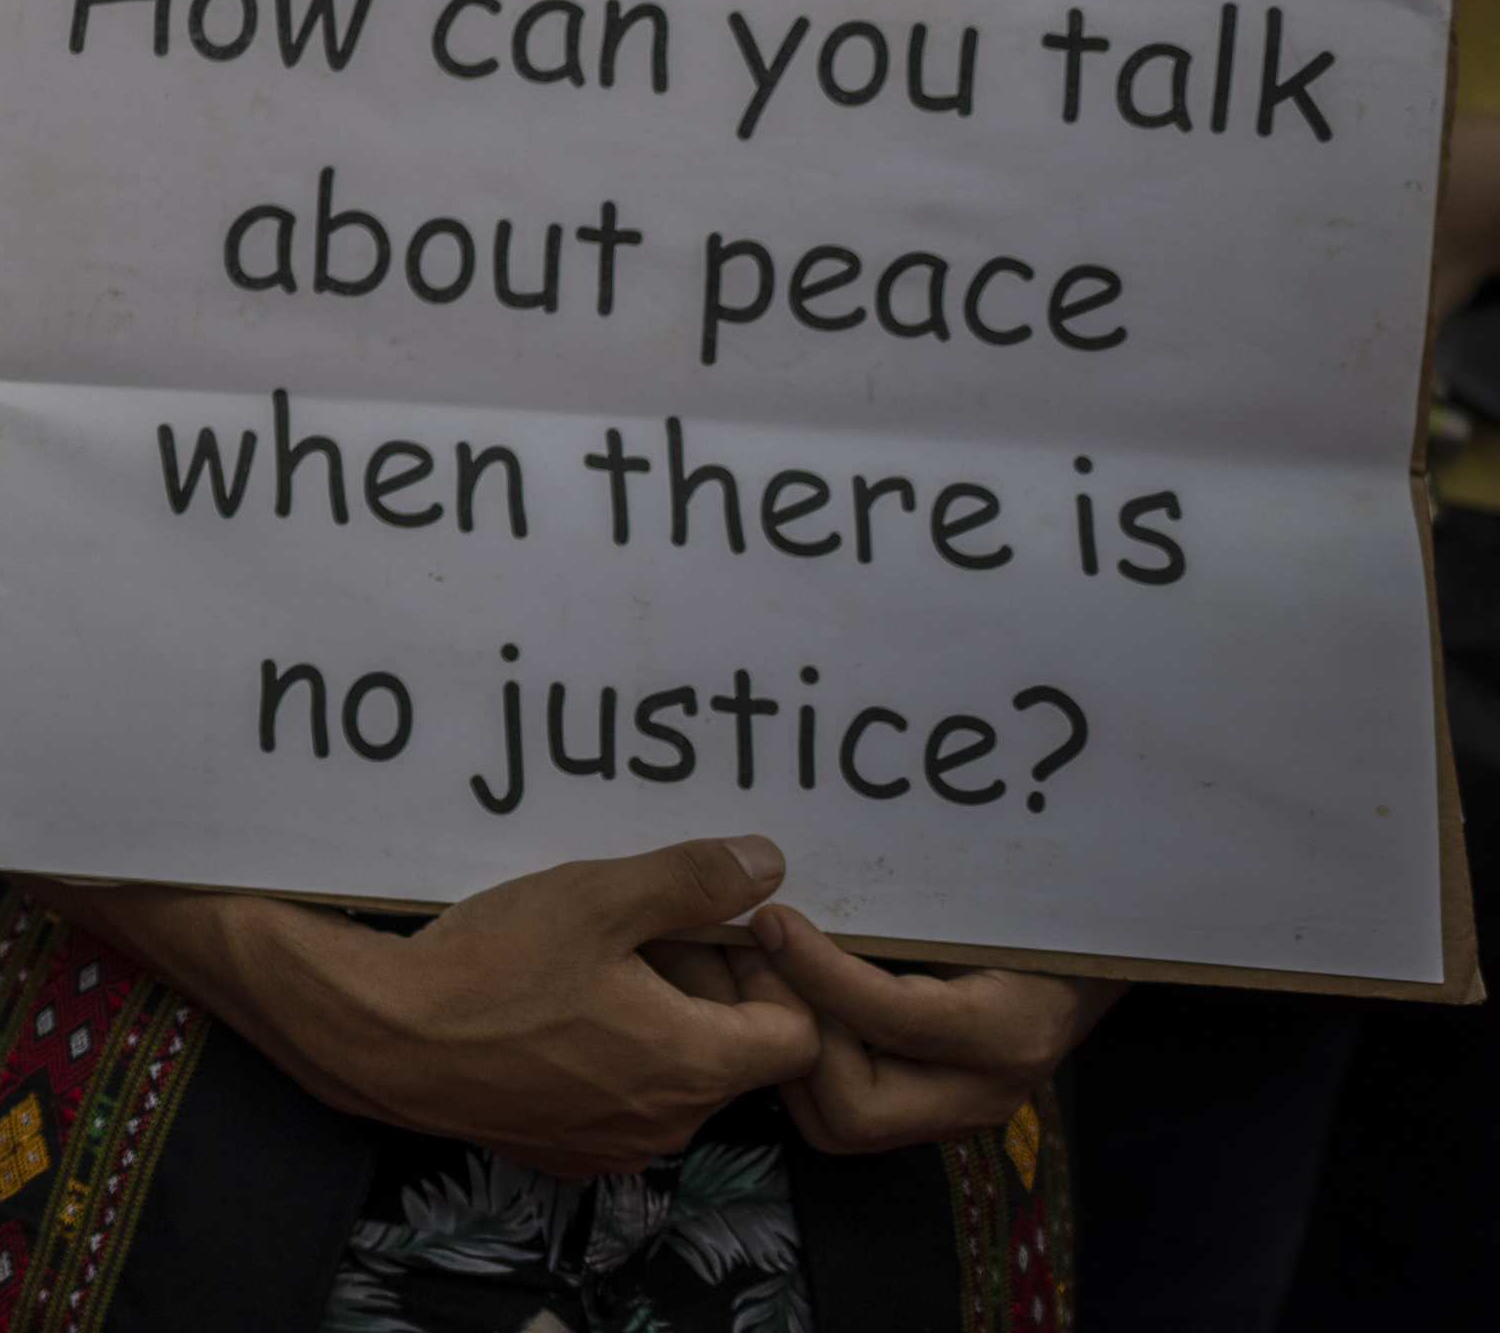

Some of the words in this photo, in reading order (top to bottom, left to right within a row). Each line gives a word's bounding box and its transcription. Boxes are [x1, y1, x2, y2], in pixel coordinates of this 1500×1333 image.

[729, 12, 978, 140] you
[1042, 3, 1335, 143] talk
[224, 167, 642, 316] about
[701, 232, 1128, 366] peace
[158, 388, 527, 538] when
[585, 416, 1013, 570] there
[1072, 456, 1187, 586] is
[259, 659, 413, 762] no
[470, 644, 1089, 815] justice?
